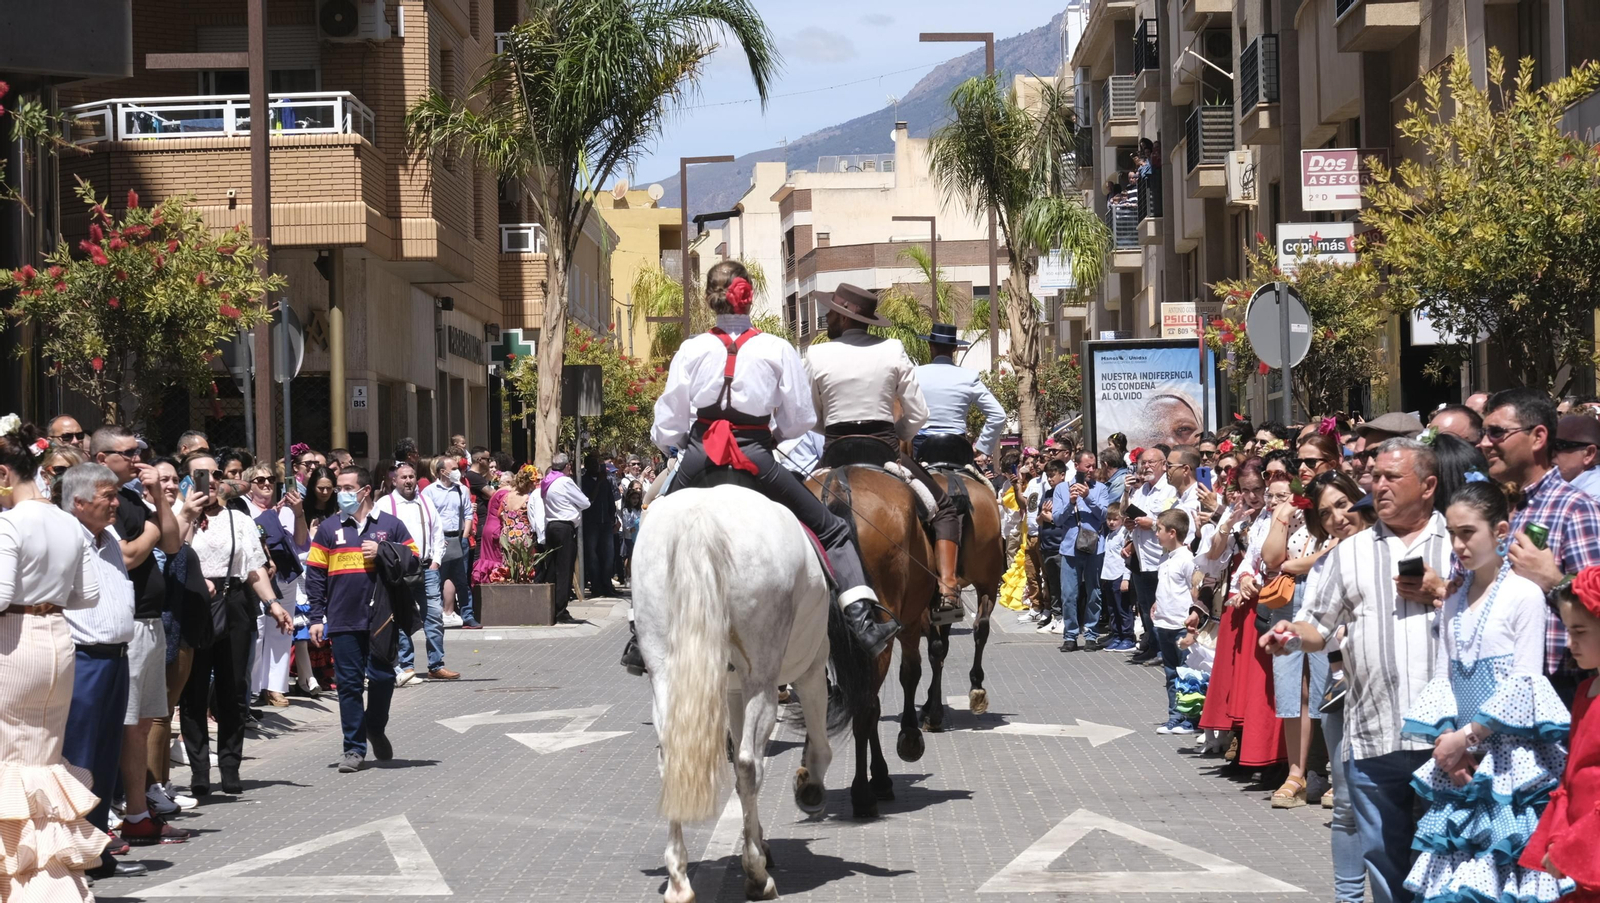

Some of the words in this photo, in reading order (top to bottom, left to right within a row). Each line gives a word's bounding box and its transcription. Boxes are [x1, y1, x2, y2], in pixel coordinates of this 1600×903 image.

[1307, 155, 1347, 171] Dos
[1164, 314, 1222, 324] PSICOLGO
[1101, 372, 1138, 381] NUESTRA
[1140, 370, 1193, 380] INDIFERENCIA
[1101, 382, 1117, 391] LOS
[1118, 381, 1156, 390] CONDENA
[358, 388, 363, 396] 5
[1101, 392, 1112, 401] AL
[1113, 391, 1142, 400] OLVIDO
[353, 400, 366, 408] BIS
[335, 529, 346, 545] 1
